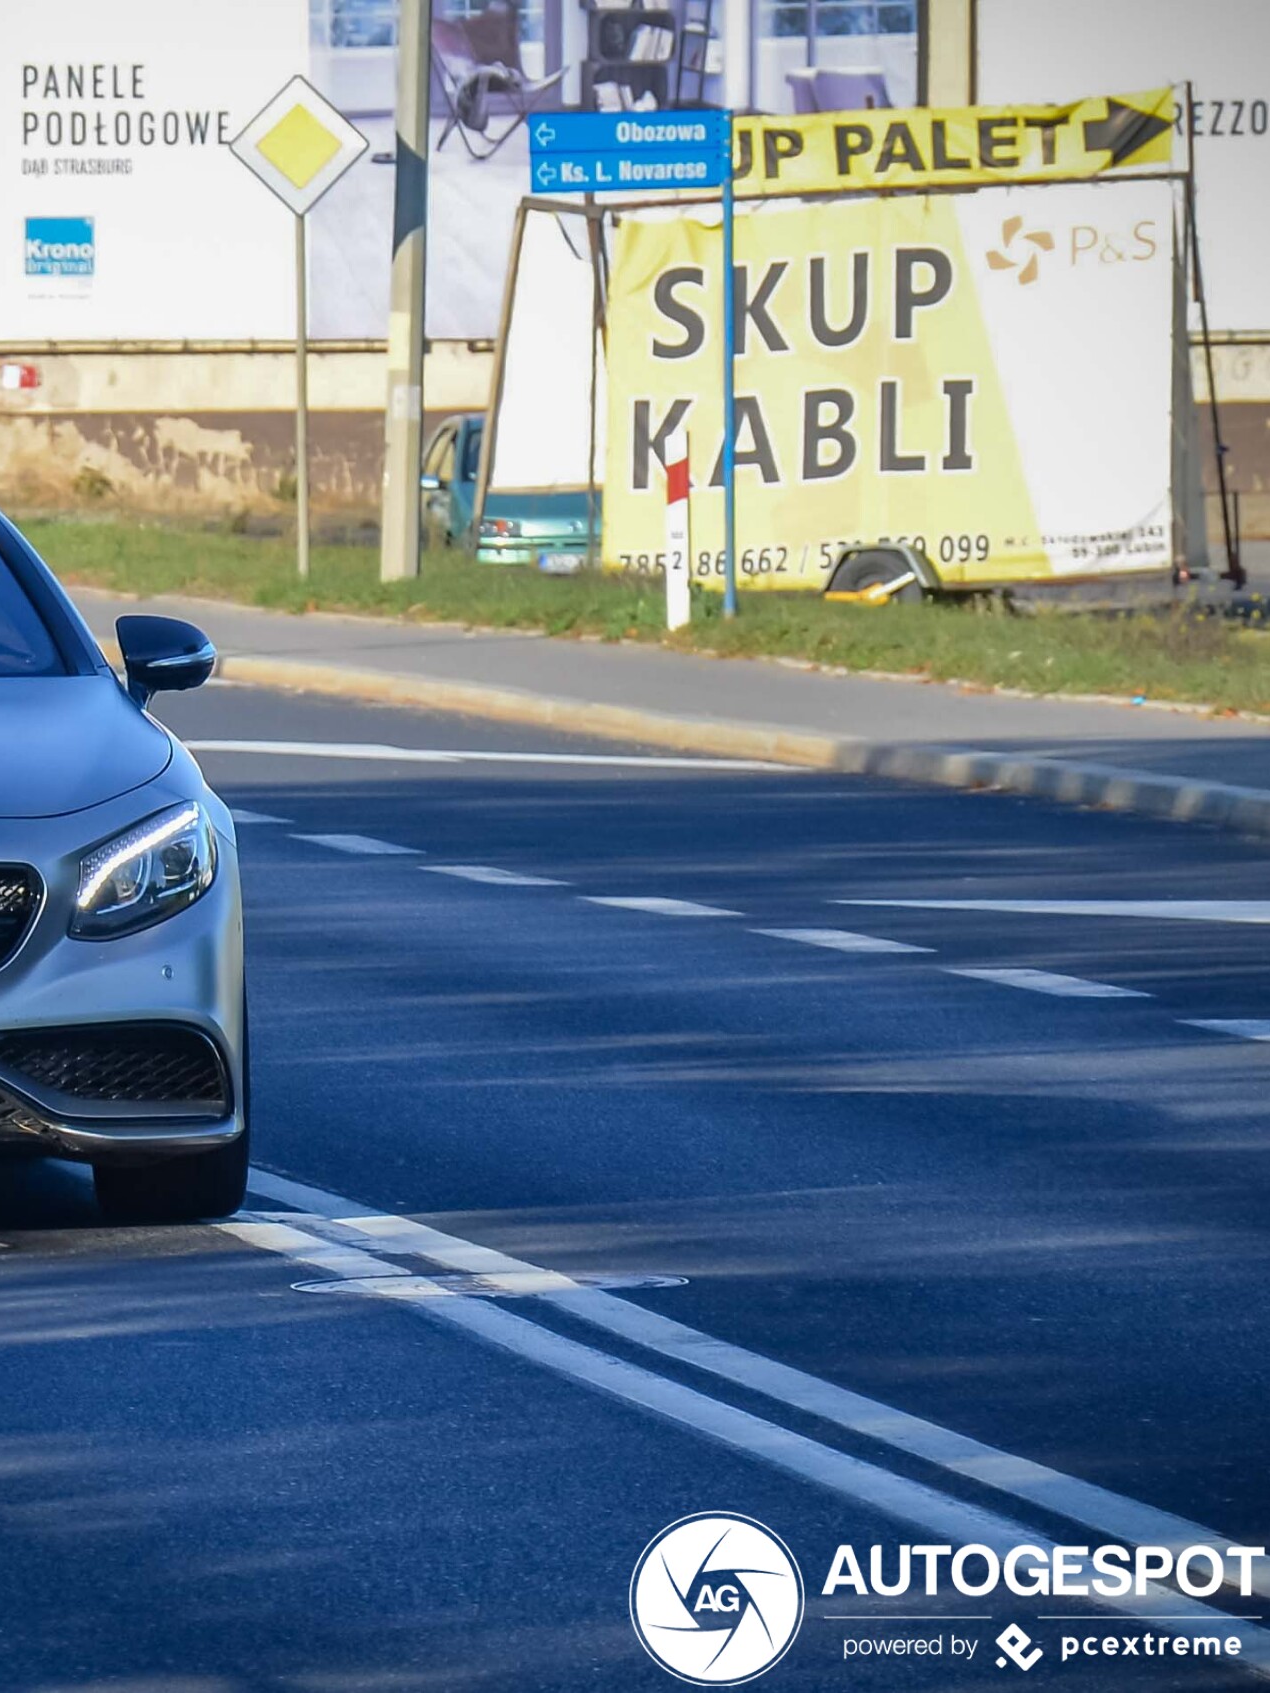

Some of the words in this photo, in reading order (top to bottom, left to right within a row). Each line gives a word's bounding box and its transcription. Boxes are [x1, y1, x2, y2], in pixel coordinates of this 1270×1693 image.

[22, 64, 145, 99] PANELE
[22, 111, 230, 146] PODŁOGOWE
[616, 121, 706, 143] Obozowa
[835, 114, 1070, 175] PALET
[22, 158, 48, 178] DĄB
[54, 158, 133, 175] STRASBURG
[560, 162, 589, 183] Ks.
[596, 161, 612, 182] L.
[618, 160, 708, 181] Novarese
[26, 238, 94, 260] Krono
[1072, 220, 1157, 265] P&S
[652, 248, 953, 359] SKUP
[632, 380, 973, 489] KABLI
[741, 547, 788, 574] 662
[939, 534, 990, 563] 099
